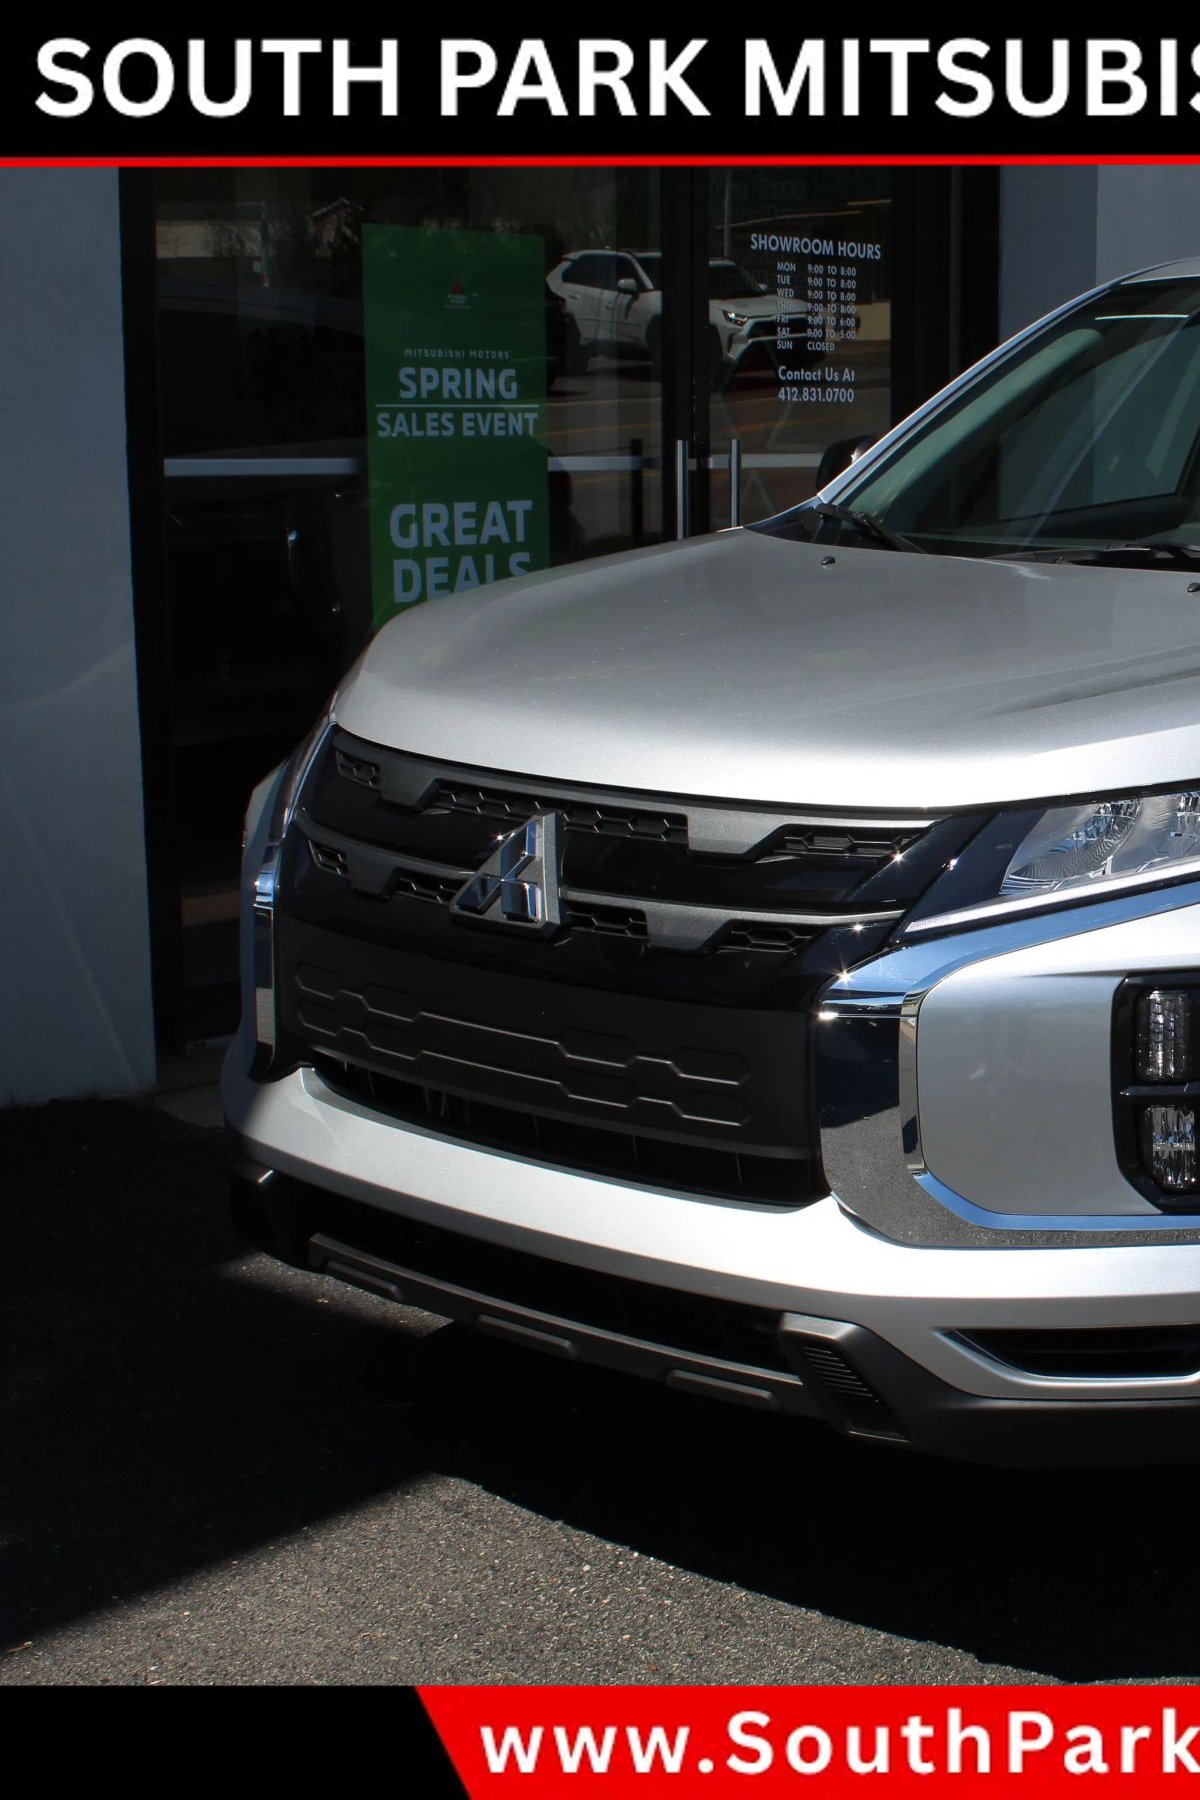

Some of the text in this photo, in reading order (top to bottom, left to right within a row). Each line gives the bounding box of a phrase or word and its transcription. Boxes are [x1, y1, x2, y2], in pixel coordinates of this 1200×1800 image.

[750, 233, 881, 260] SHOWROOM HOURS
[776, 262, 856, 276] MON 9:00 TO 8:00
[776, 275, 856, 290] TUE 9:00 TO 8:00
[776, 288, 856, 302] WED 9:00 TO 8:00
[807, 303, 824, 314] 9:00
[826, 304, 837, 314] TO
[840, 305, 856, 316] 8:00
[776, 314, 789, 324] FRI
[807, 316, 824, 327] 9:00
[826, 317, 837, 327] TO
[776, 327, 791, 337] SAT
[807, 329, 824, 340] 9:00
[826, 330, 837, 340] TO
[777, 340, 835, 351] SUN CLOSED
[404, 349, 511, 360] MITSUBISHI MOTORS
[778, 365, 855, 382] Contact Us At
[398, 367, 518, 399] SPRING
[778, 387, 855, 402] 412.831.0700
[376, 412, 539, 437] SALES EVENT
[389, 500, 533, 548] GREAT
